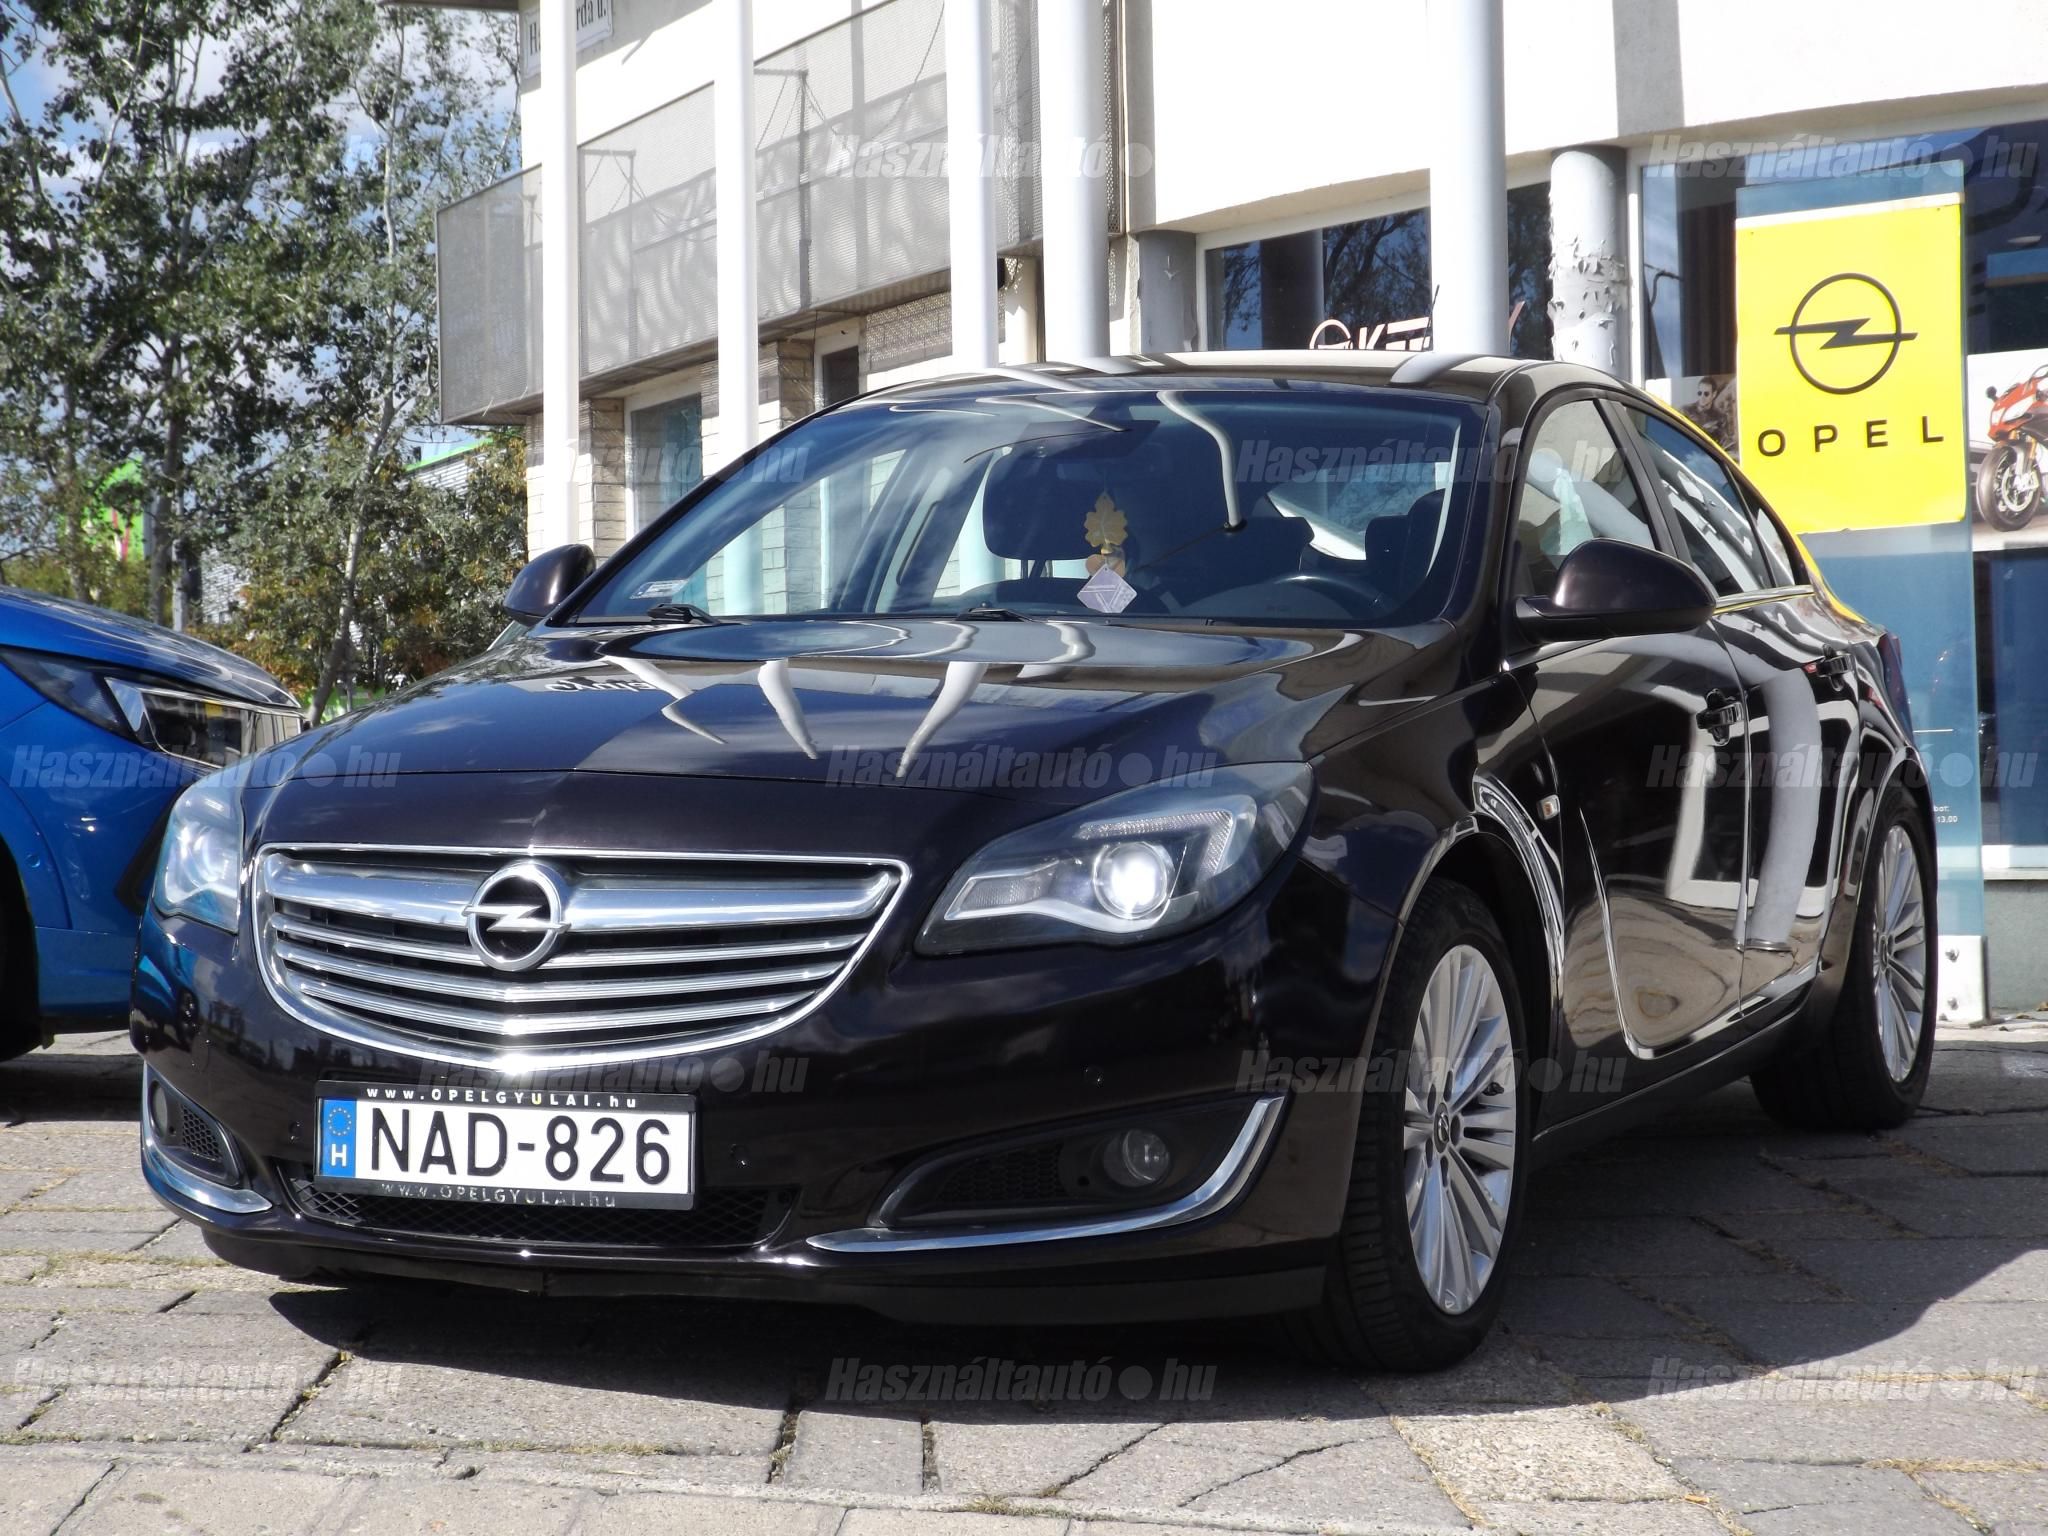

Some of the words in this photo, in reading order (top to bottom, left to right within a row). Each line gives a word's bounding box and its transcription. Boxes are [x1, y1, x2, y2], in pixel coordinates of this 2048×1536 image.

[1757, 415, 1945, 457] OPEL
[366, 1088, 637, 1108] www.OPELGYULAI.hu
[331, 1143, 347, 1167] H
[371, 1107, 670, 1185] NAD-826
